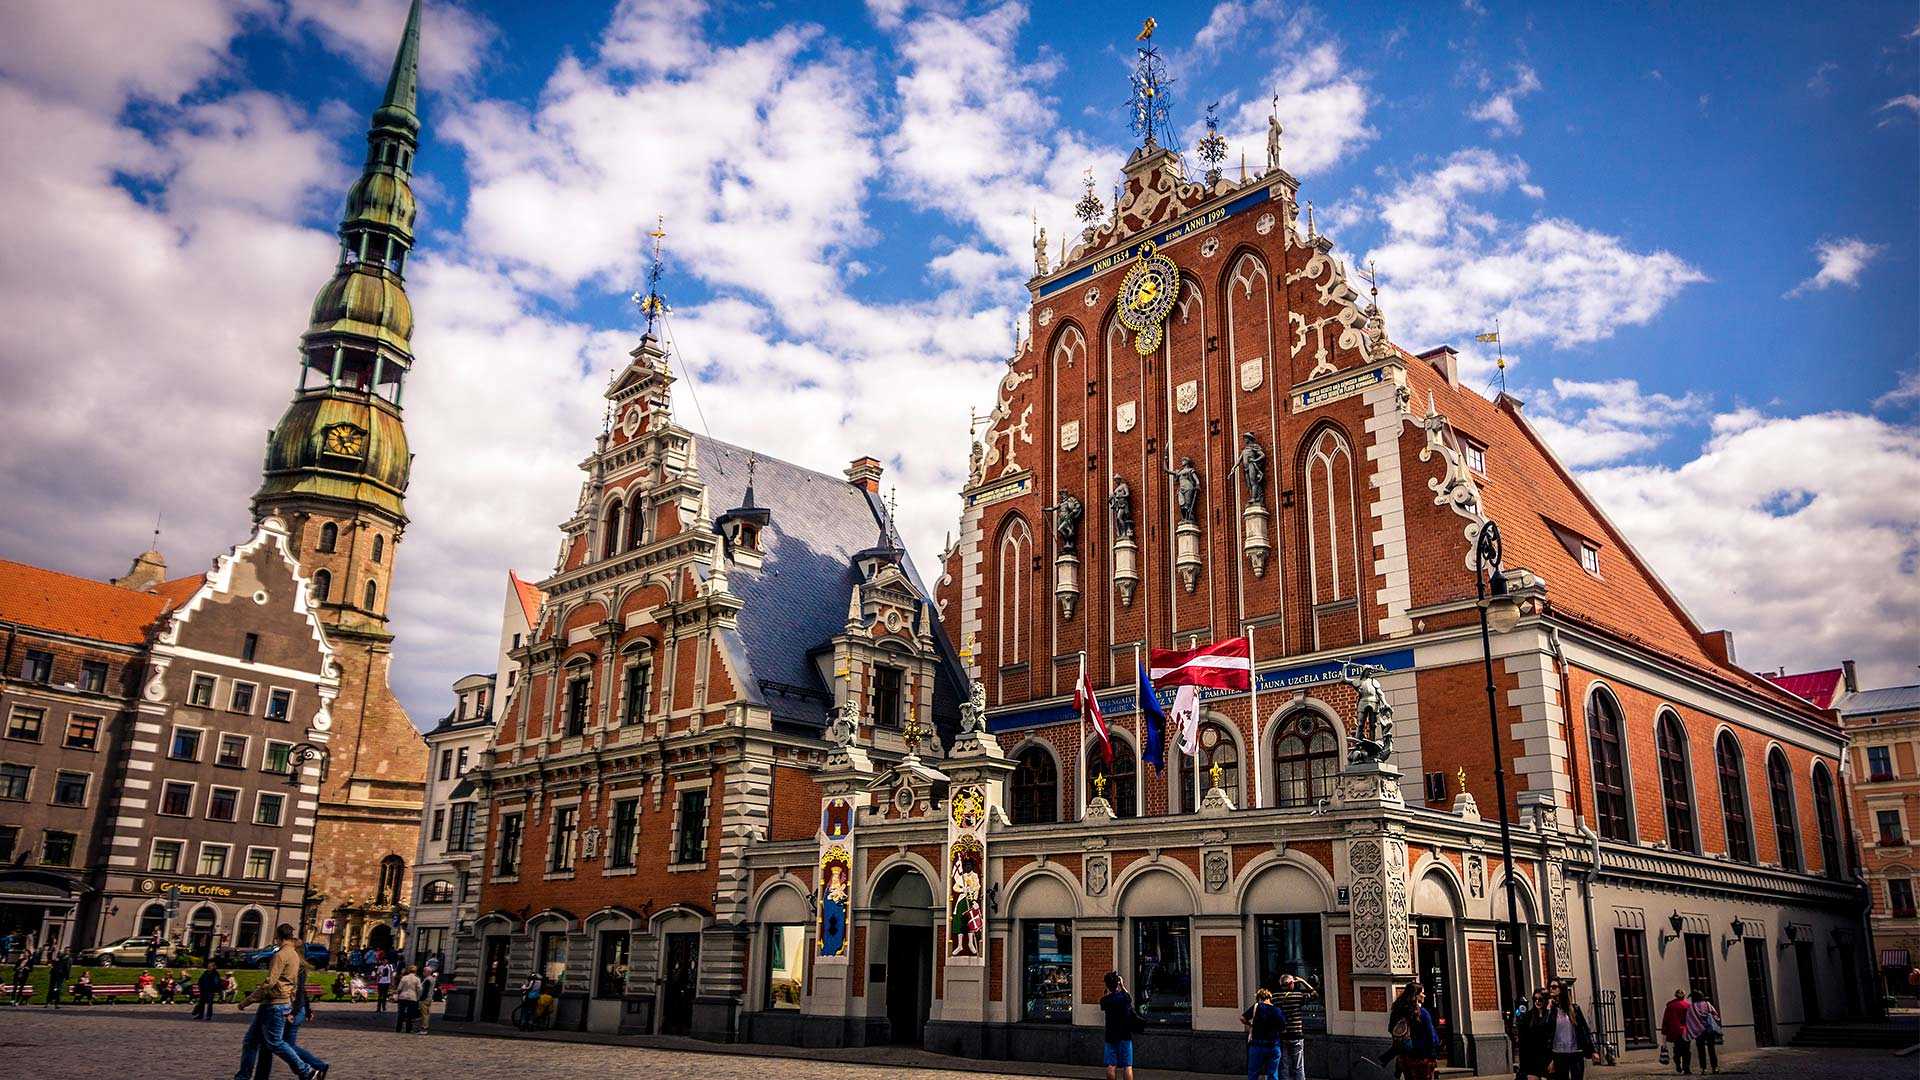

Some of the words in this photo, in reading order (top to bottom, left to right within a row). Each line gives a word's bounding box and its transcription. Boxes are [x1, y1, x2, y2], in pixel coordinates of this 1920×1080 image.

[1092, 257, 1111, 274] ANNO
[1184, 216, 1206, 234] ANNO
[1208, 208, 1225, 223] 1999
[1261, 680, 1285, 690] JAUNA
[198, 885, 231, 896] Coffee
[1340, 890, 1345, 898] 7
